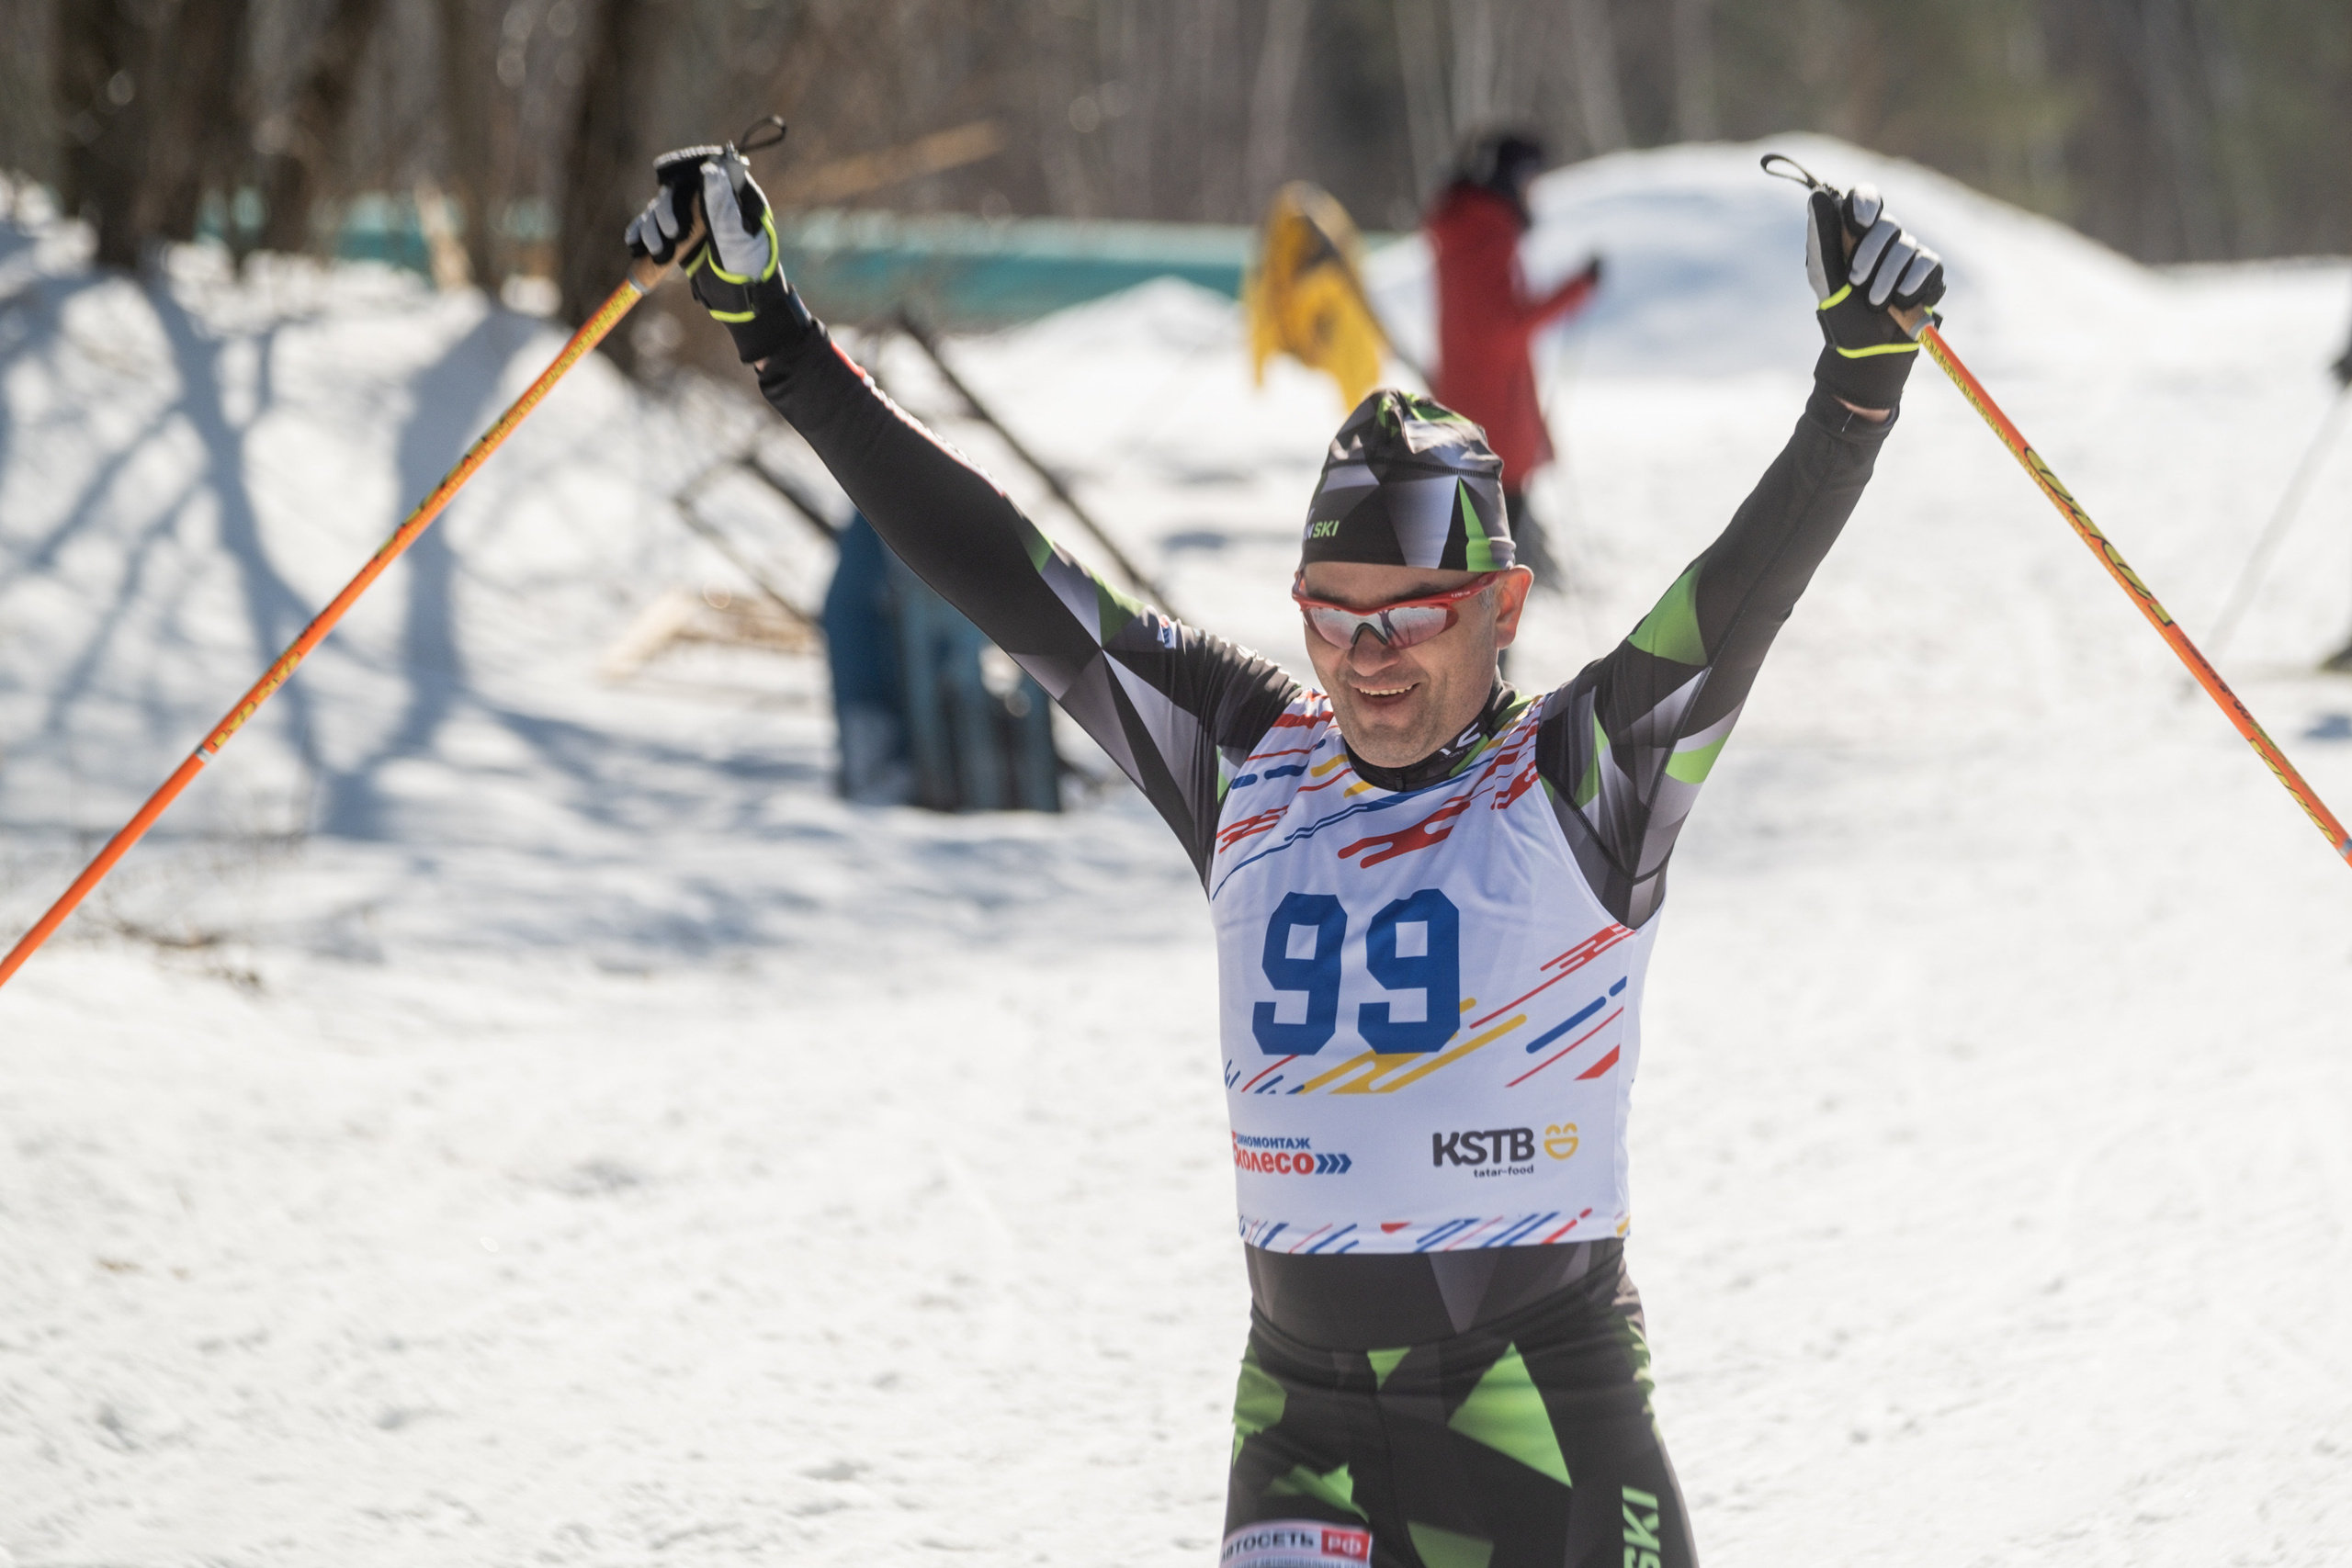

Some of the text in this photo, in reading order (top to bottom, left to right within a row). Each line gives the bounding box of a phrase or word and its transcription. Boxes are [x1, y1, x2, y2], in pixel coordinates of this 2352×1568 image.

[1252, 888, 1460, 1055] 99
[1432, 1127, 1535, 1167] KSTB
[1474, 1165, 1534, 1178] tatar-food
[1328, 1535, 1362, 1556] РФ
